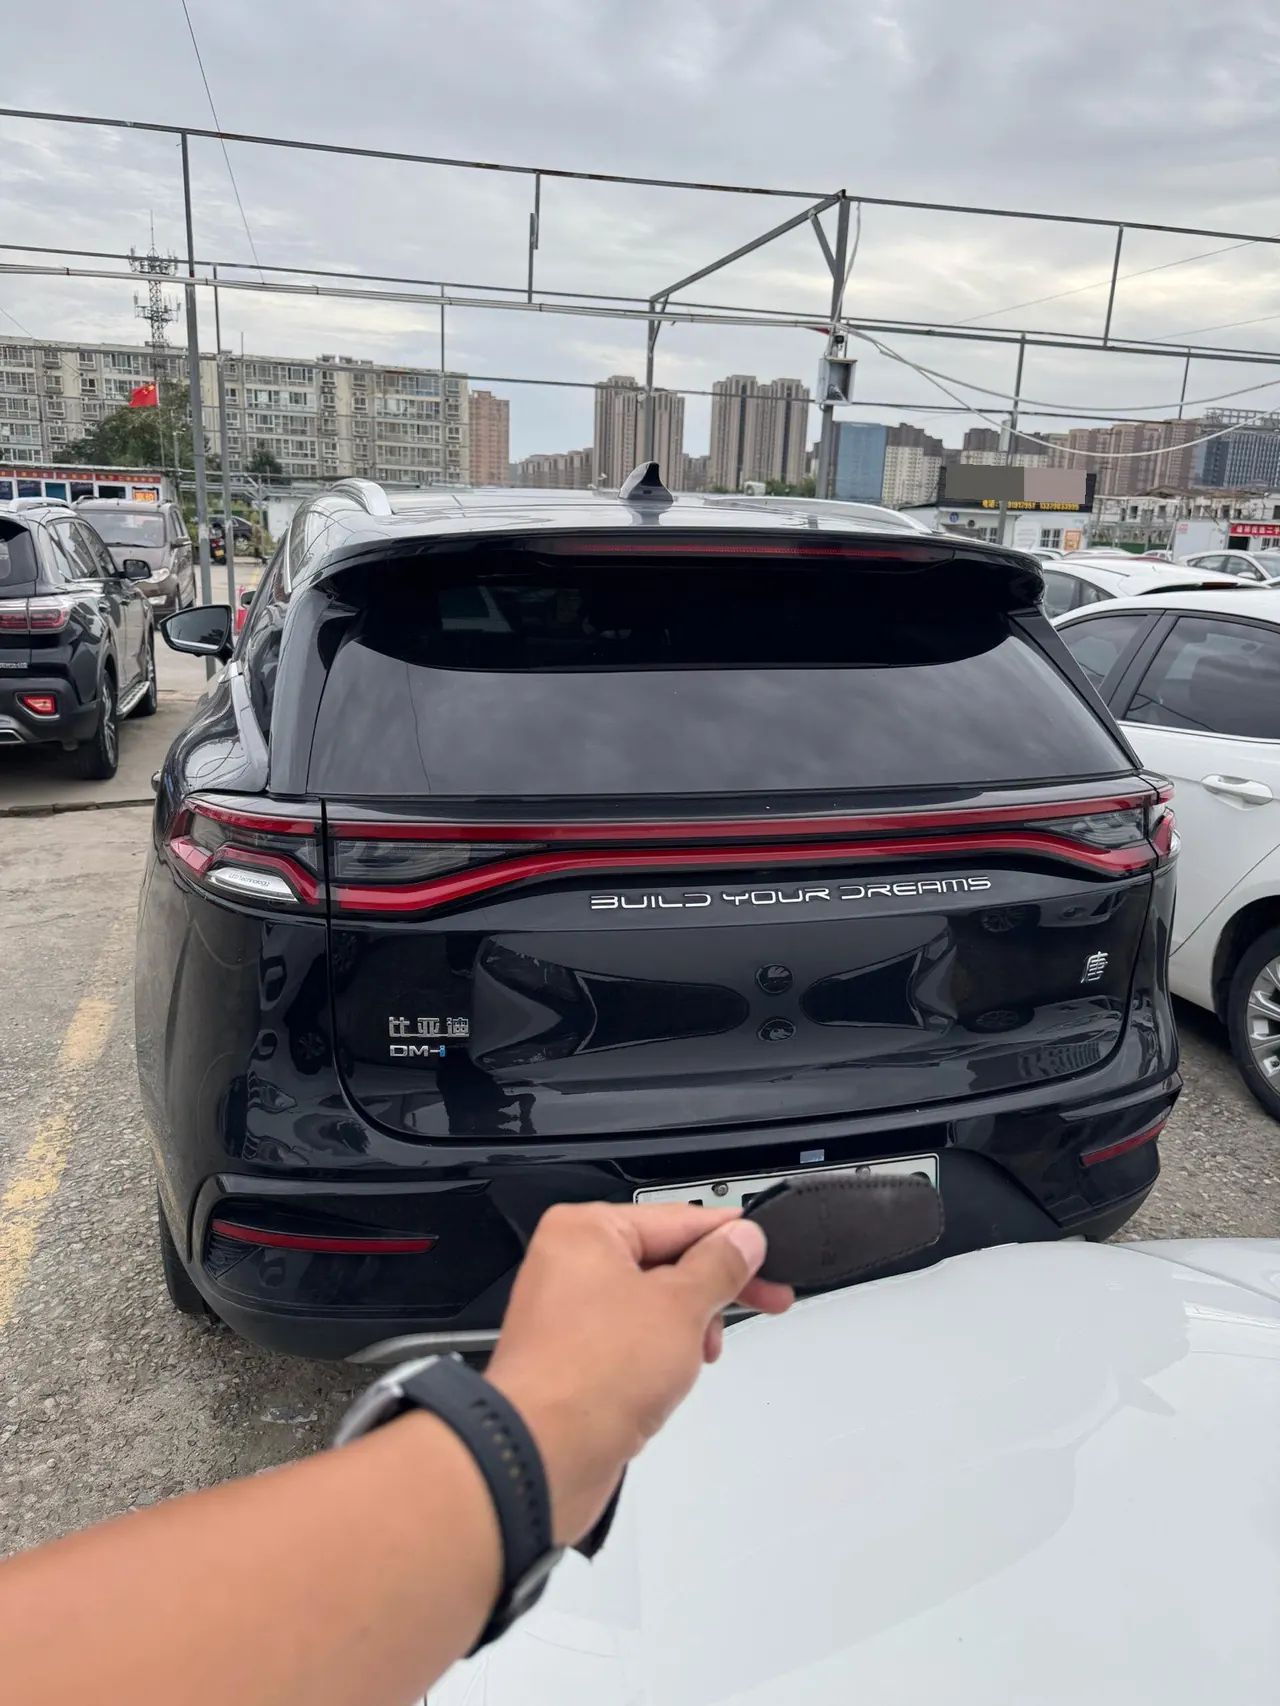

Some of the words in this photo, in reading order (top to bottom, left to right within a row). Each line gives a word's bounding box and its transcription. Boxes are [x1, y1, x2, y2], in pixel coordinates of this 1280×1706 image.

[590, 893, 712, 910] BUILD
[722, 888, 830, 906] YOUR
[840, 876, 992, 901] DREAMS
[1080, 951, 1109, 984] 唐
[388, 1016, 470, 1038] 比亚迪
[389, 1044, 446, 1057] DM-i
